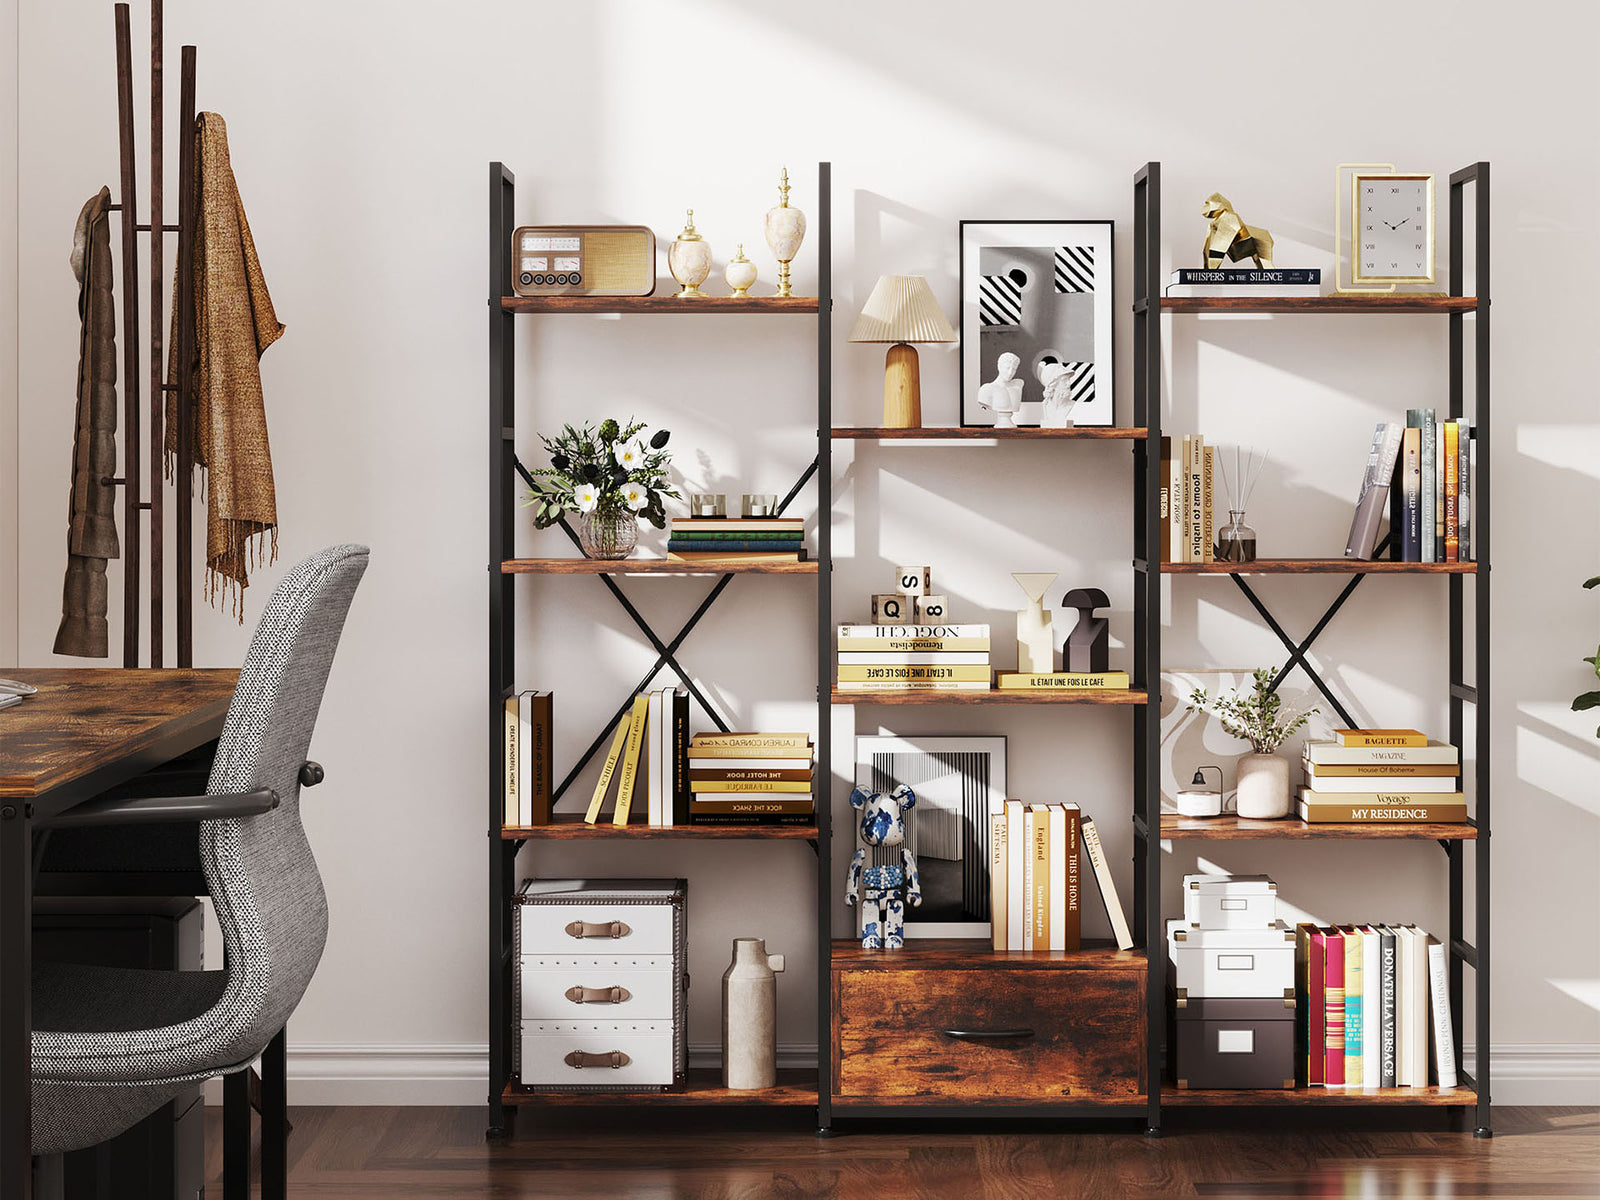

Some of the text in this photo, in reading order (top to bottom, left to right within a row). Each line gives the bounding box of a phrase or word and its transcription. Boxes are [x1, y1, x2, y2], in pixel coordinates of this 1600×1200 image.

[1186, 272, 1224, 281] WHISPERS
[1250, 272, 1283, 281] SILENCE
[884, 600, 900, 618] Q
[926, 606, 942, 616] 8
[876, 627, 959, 637] NOGUCHI
[886, 669, 893, 677] LE
[895, 669, 910, 677] FOIS
[911, 669, 925, 677] UNE
[927, 669, 944, 678] ÉTAIT
[946, 669, 952, 677] IL
[1037, 678, 1053, 686] ÉTAIT
[1090, 678, 1104, 686] CAFÉ
[600, 755, 617, 788] SCHIELE
[621, 762, 633, 790] PICOULT
[1377, 794, 1410, 805] Voyage
[1352, 809, 1427, 819] MY RESIDENCE
[1090, 827, 1099, 848] PAUL
[1036, 827, 1045, 861] England
[1069, 854, 1077, 873] THIS
[1069, 875, 1077, 883] IS
[1069, 885, 1077, 911] HOME
[1035, 908, 1044, 937] Kingdom
[1384, 948, 1394, 1077] DONATELLA VERSACE
